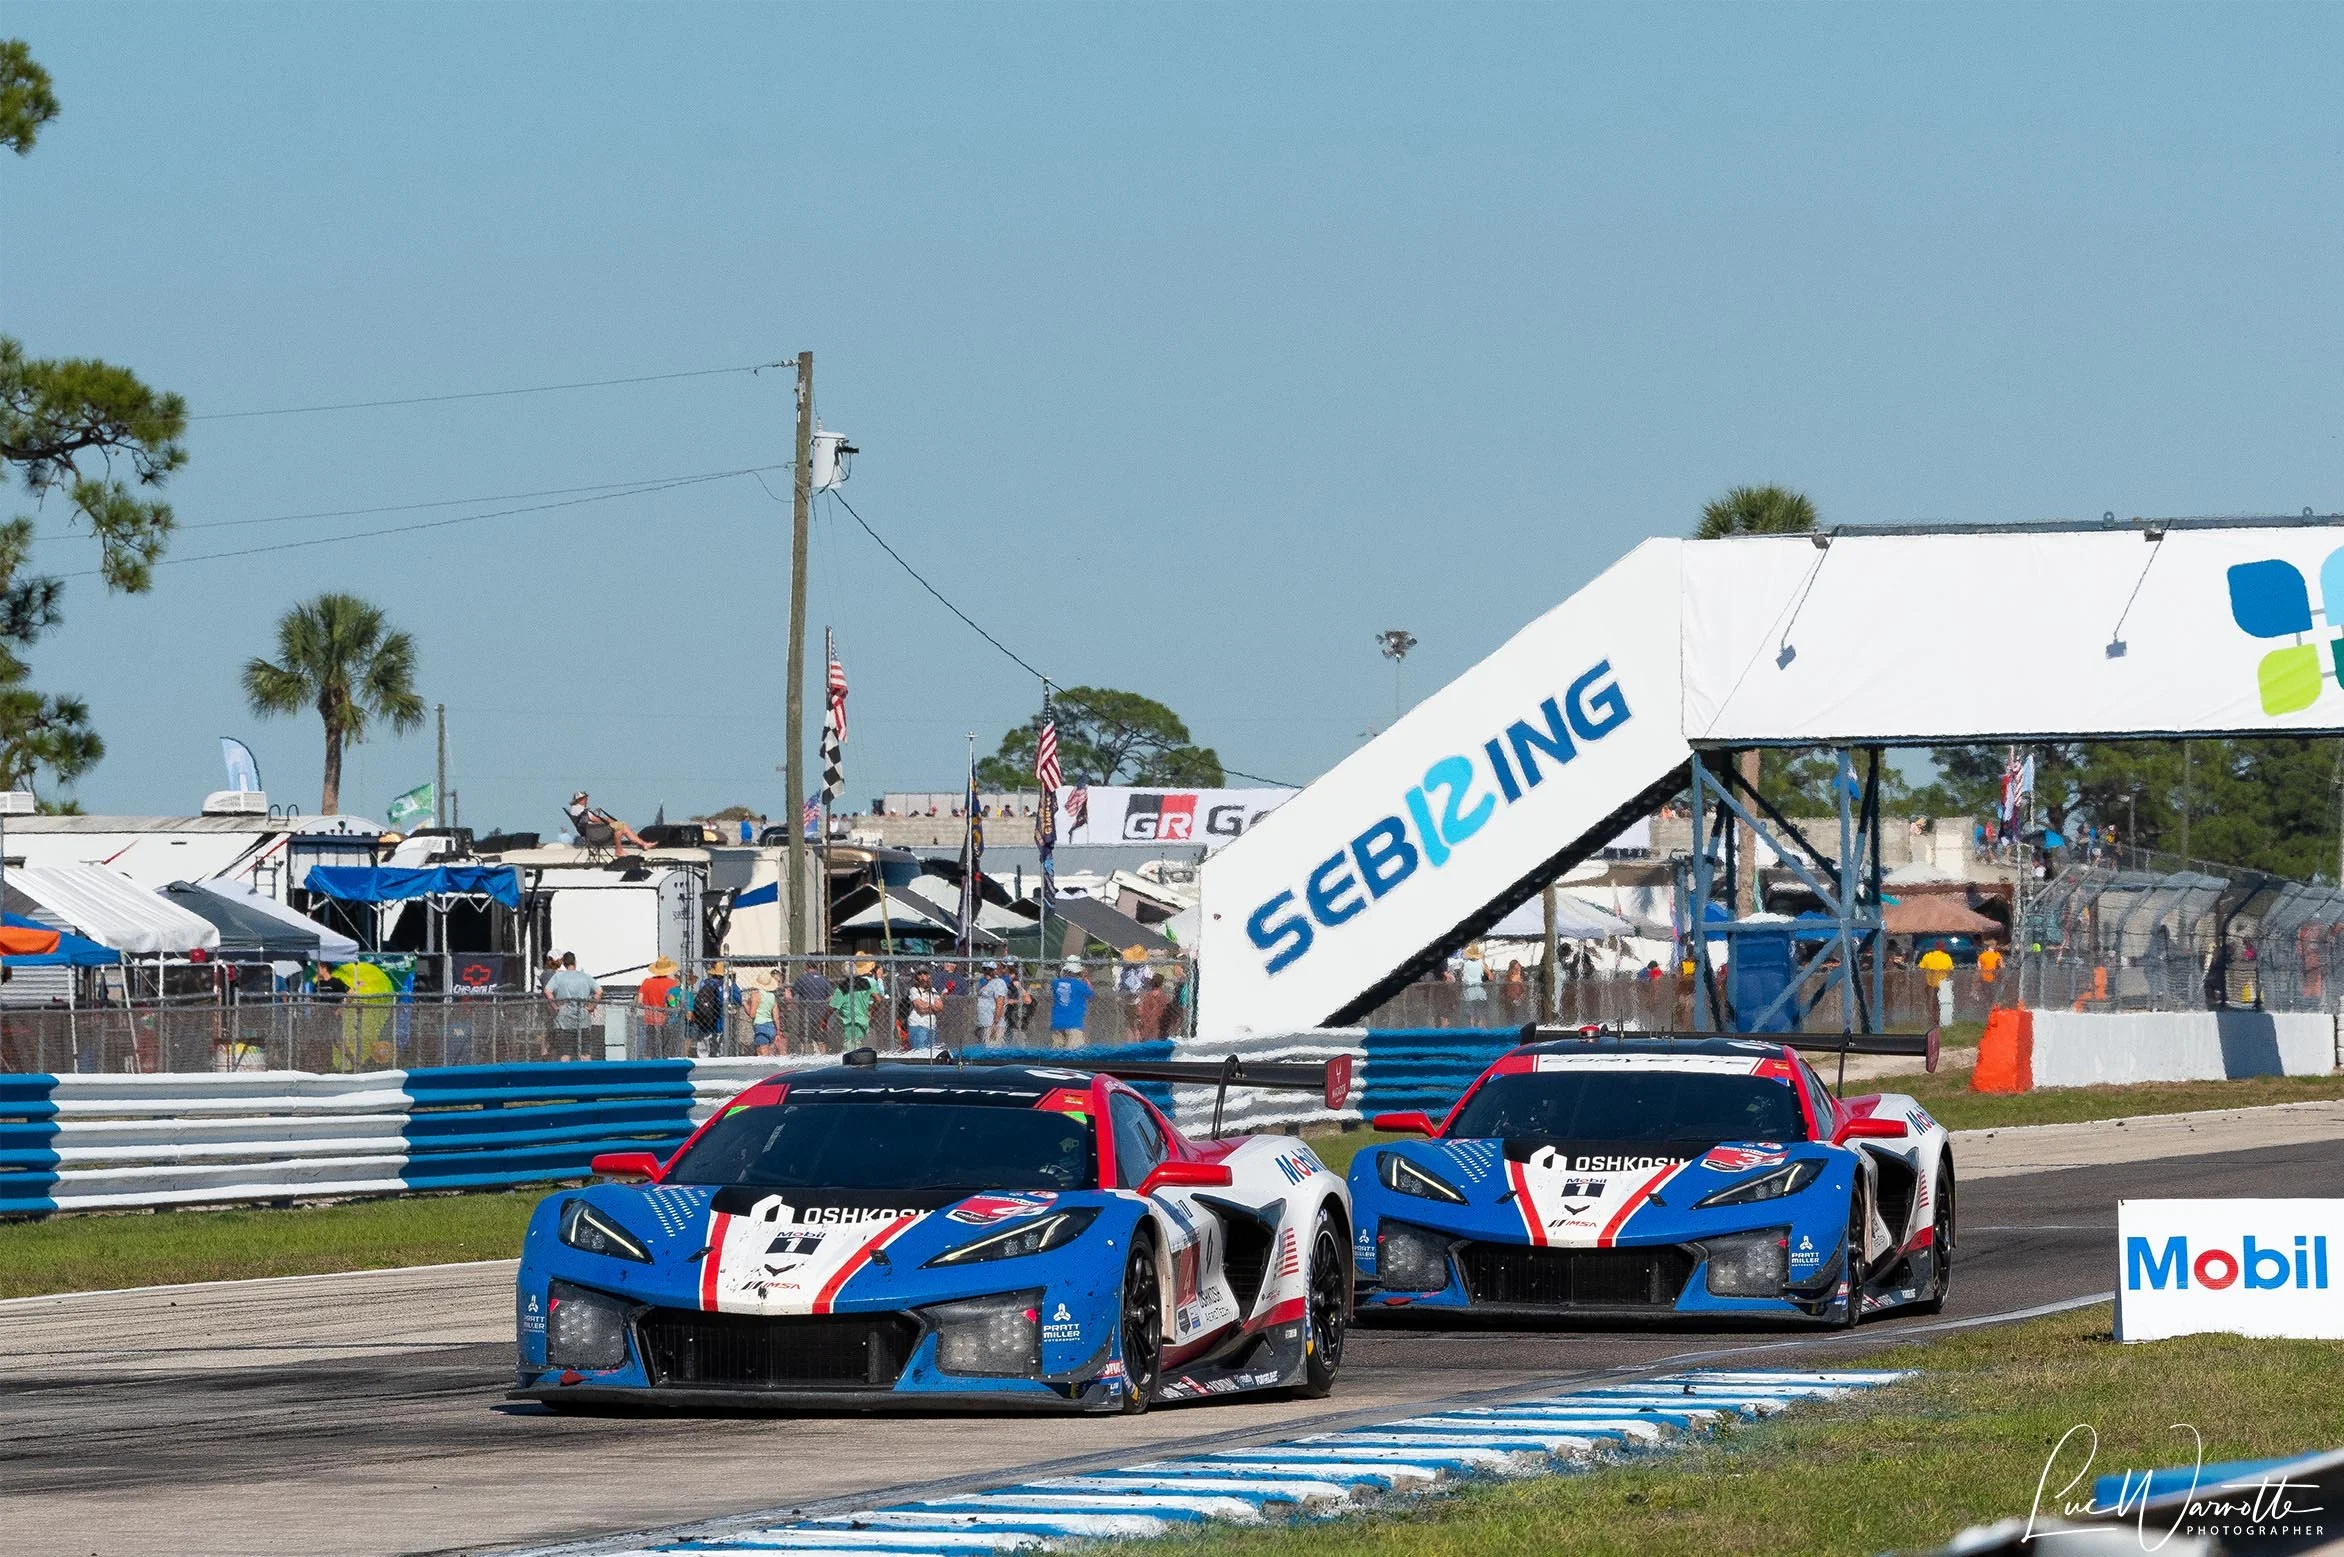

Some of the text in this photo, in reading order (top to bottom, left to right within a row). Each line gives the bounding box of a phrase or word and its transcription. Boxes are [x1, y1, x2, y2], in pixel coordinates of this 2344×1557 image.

[1125, 812, 1192, 840] GR
[791, 1088, 1041, 1097] CORVETTE
[1576, 1184, 1589, 1196] 1
[785, 1237, 802, 1253] 1
[2127, 1235, 2328, 1290] Mobil
[764, 1282, 801, 1290] IMSA
